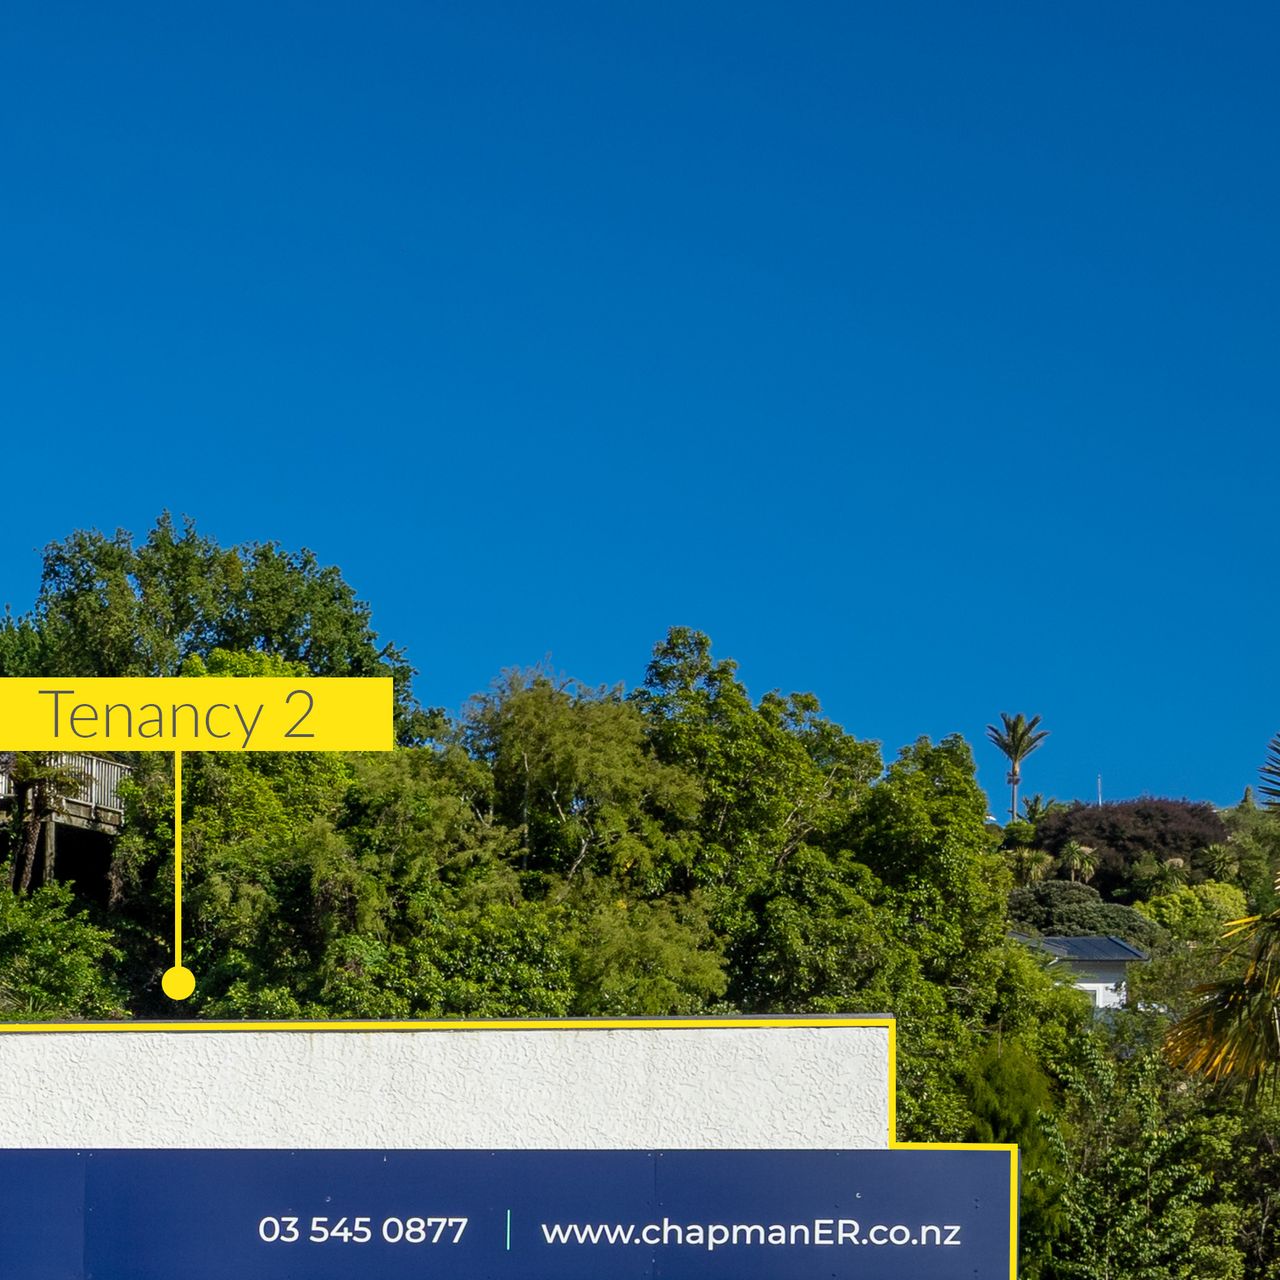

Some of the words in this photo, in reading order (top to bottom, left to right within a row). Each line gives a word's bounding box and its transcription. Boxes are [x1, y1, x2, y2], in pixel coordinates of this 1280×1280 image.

[258, 1216, 300, 1243] 03
[309, 1216, 372, 1243] 545
[382, 1216, 469, 1244] 0877
[541, 1216, 961, 1251] www.chapmanER.co.nz
